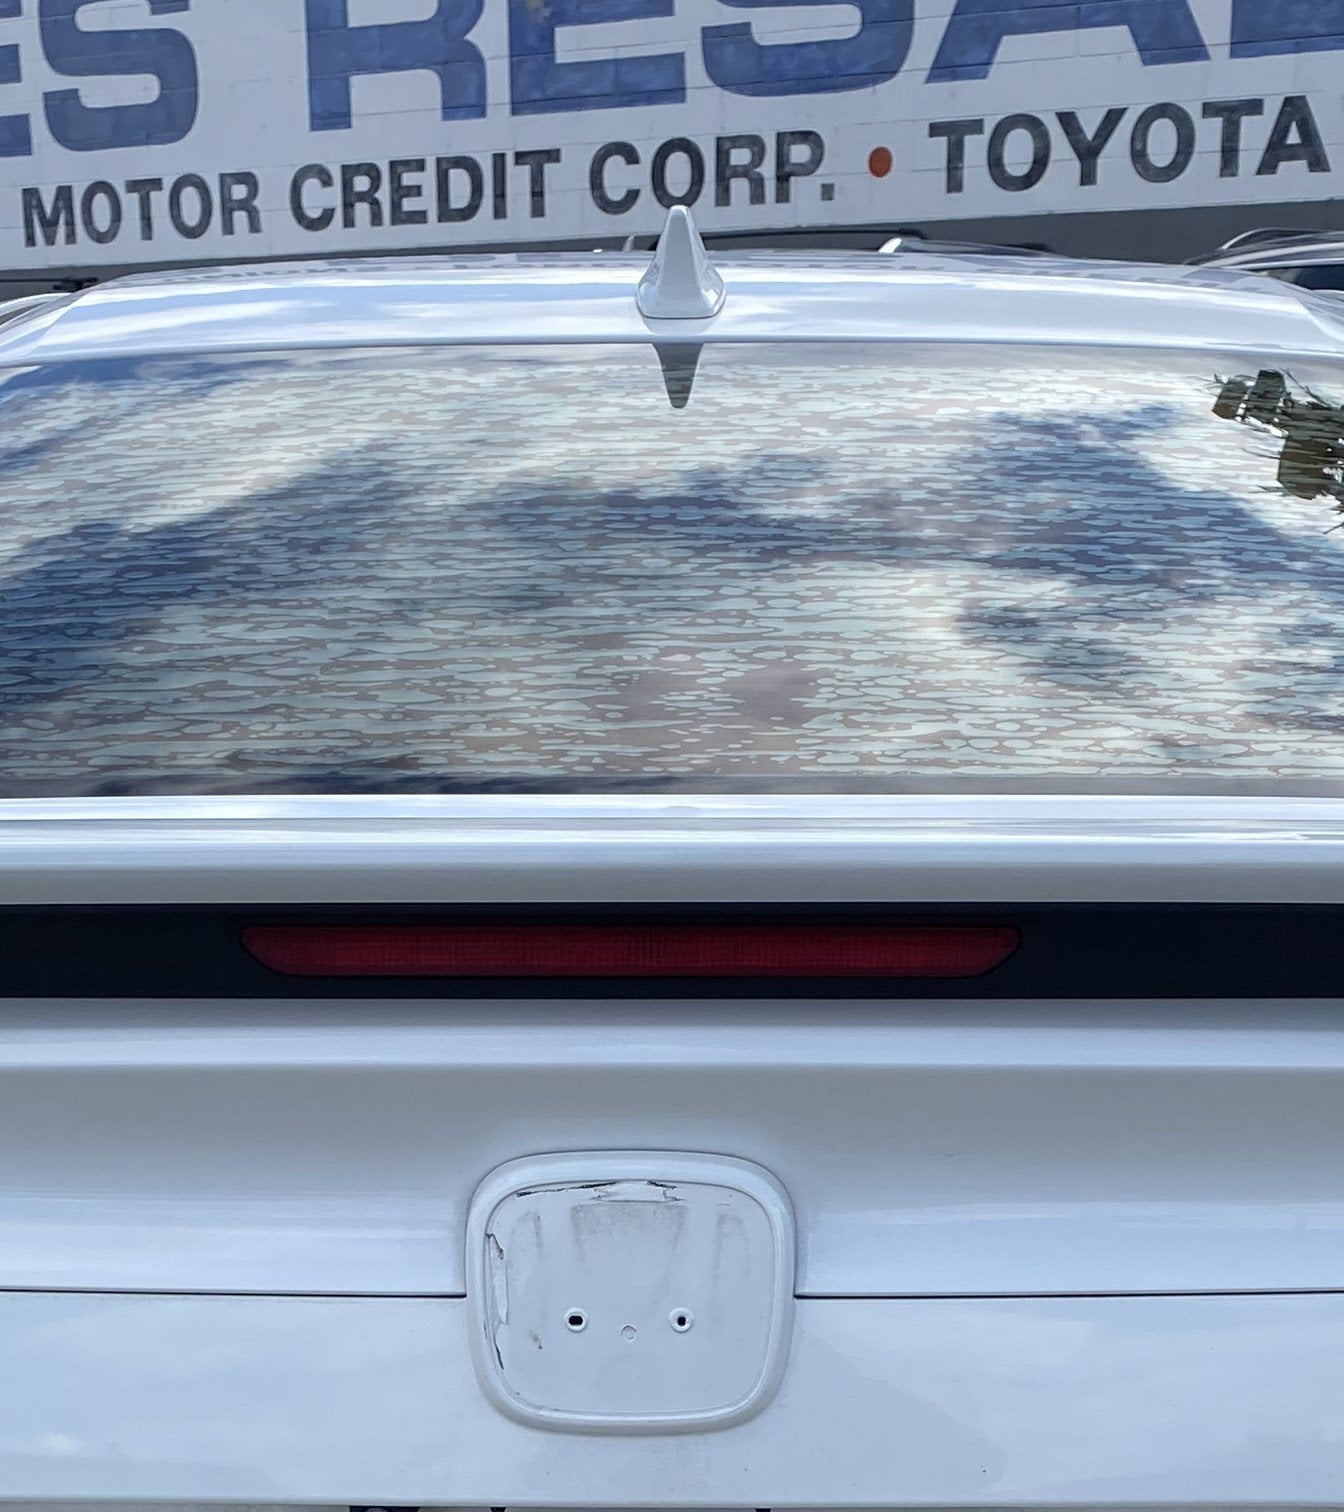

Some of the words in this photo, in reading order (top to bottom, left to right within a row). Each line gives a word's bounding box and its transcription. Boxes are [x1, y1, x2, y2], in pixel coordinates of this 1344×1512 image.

[23, 172, 262, 252] MOTOR
[289, 147, 561, 232] CREDIT
[589, 129, 835, 215] CORP.
[929, 96, 1332, 194] TOYOTA
